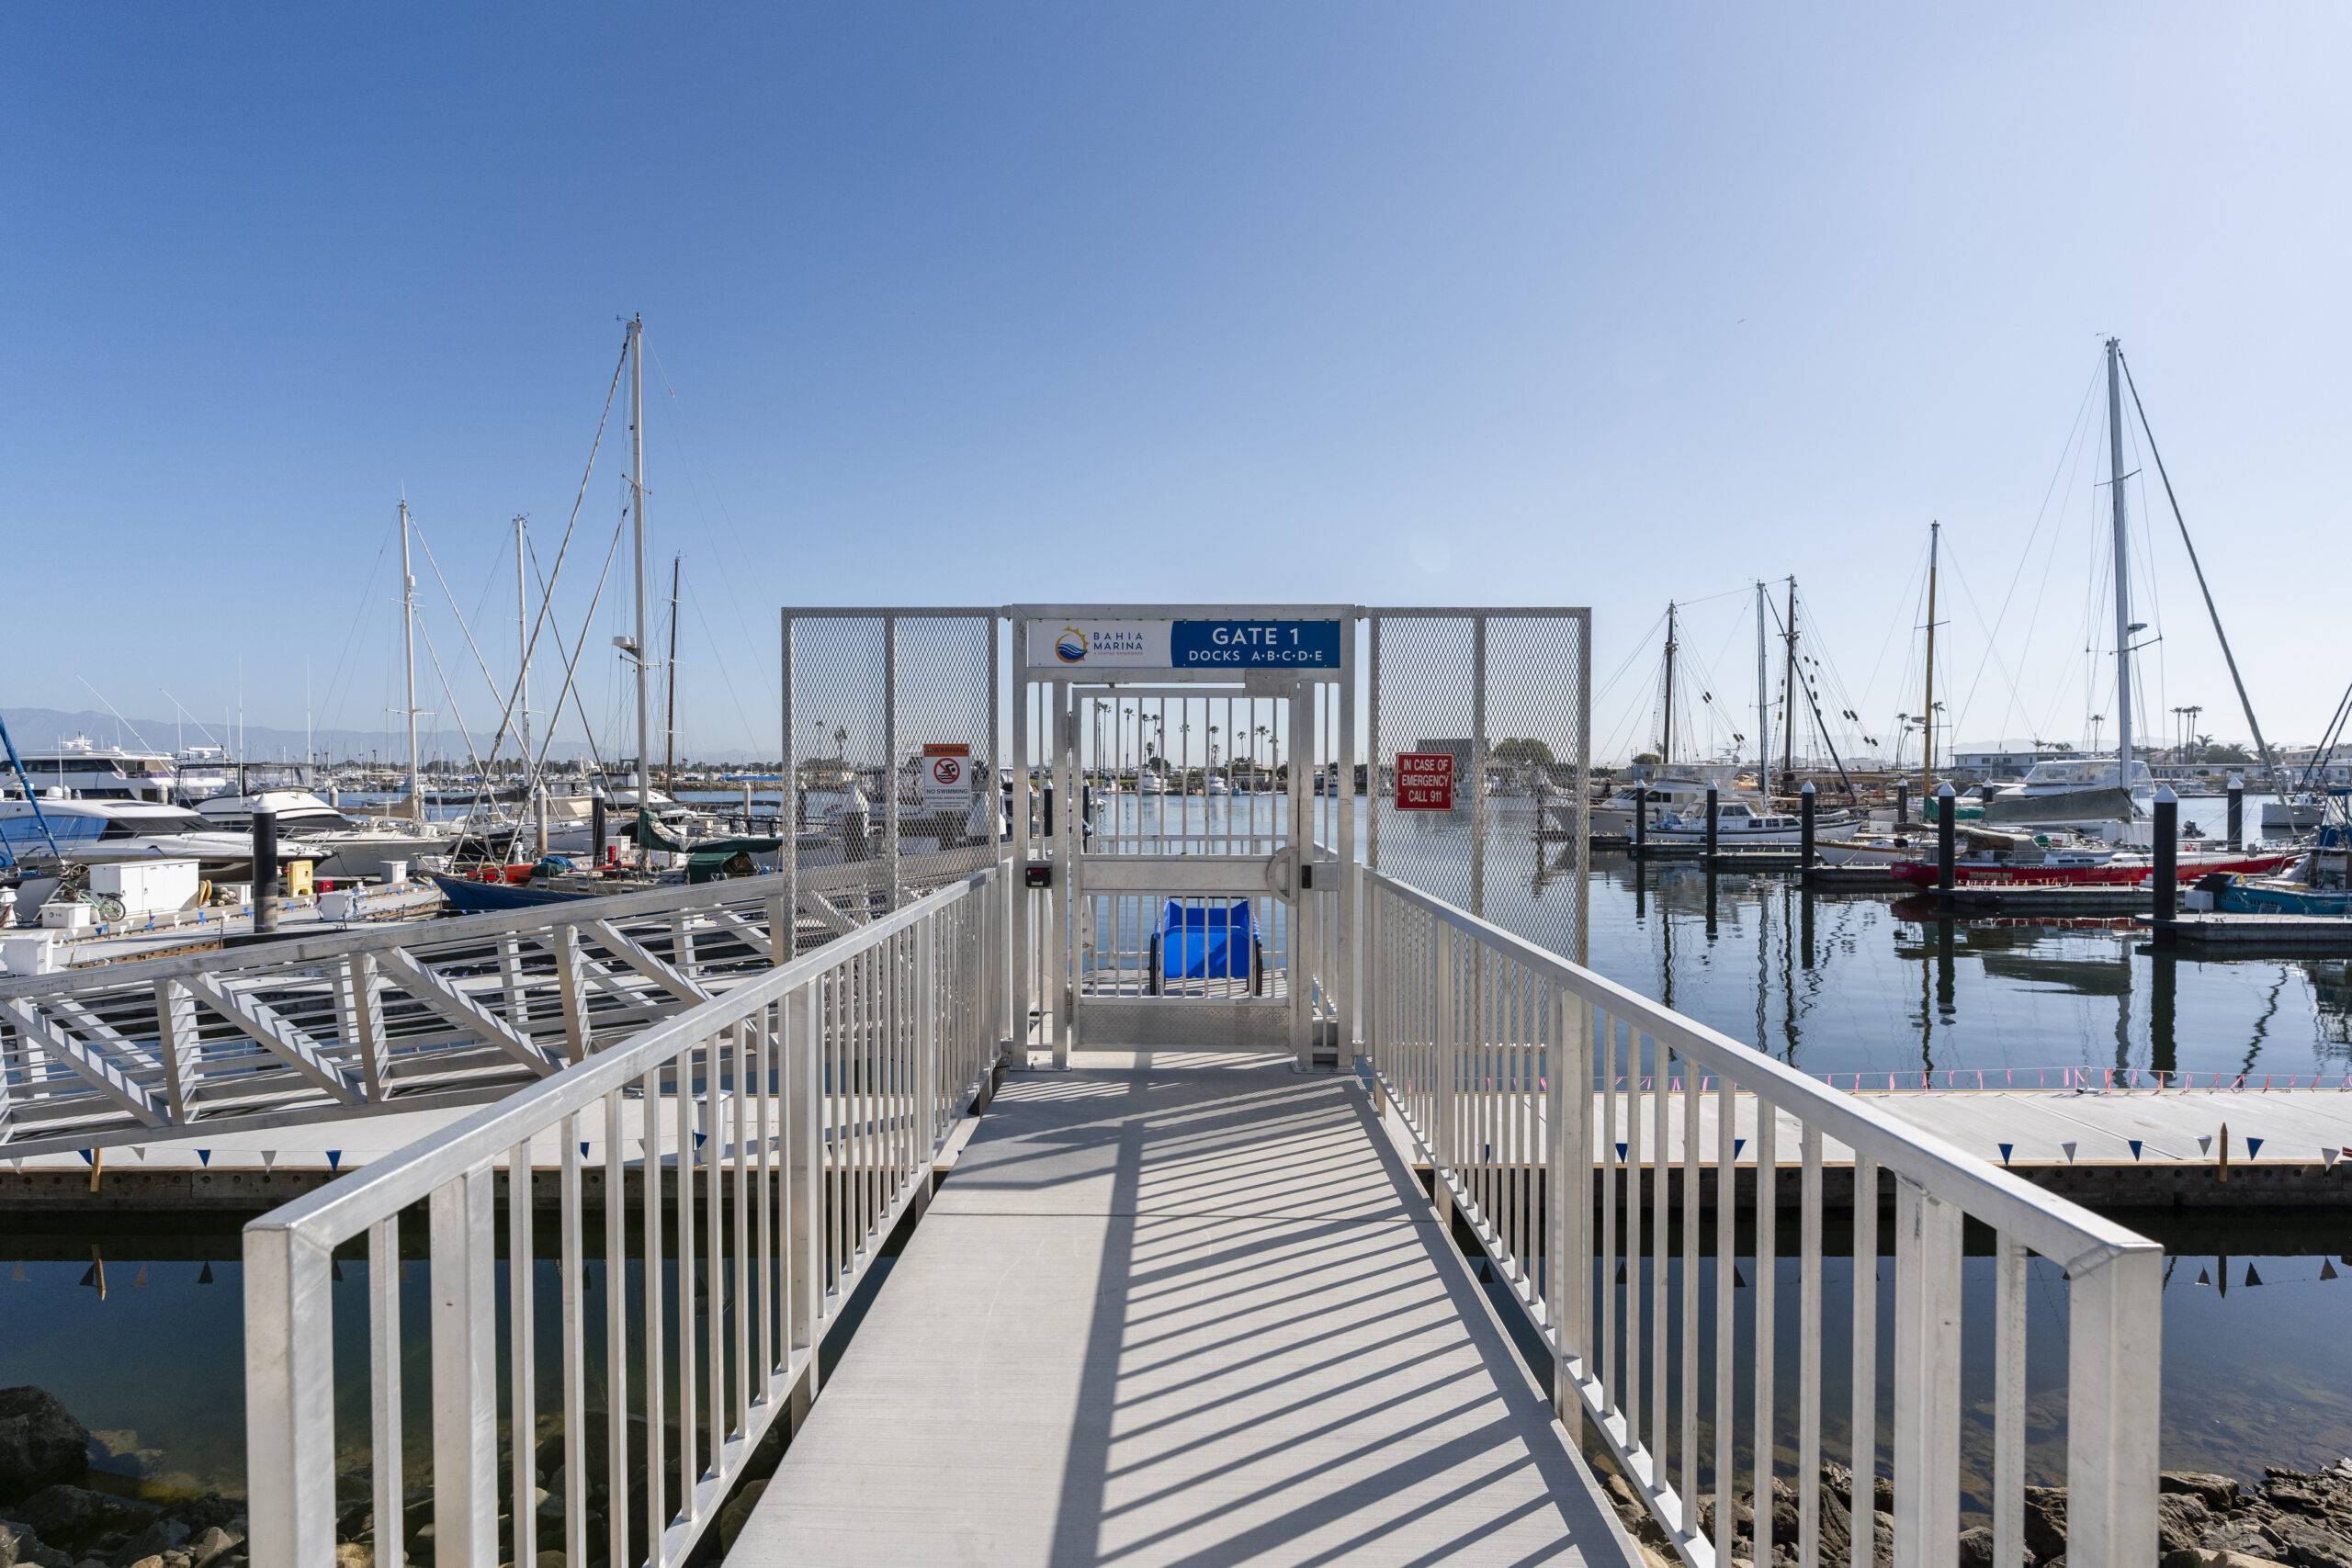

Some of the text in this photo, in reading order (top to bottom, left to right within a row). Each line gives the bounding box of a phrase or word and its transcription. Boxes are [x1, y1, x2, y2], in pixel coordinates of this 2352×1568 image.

[1094, 632, 1143, 640] BAHIA
[1212, 627, 1298, 645] GATE 1
[1094, 642, 1143, 650] MARINA
[1189, 650, 1240, 661] DOCKS
[1404, 760, 1448, 771] IN CASE OF
[1402, 775, 1449, 787] EMERGENCY
[1408, 790, 1442, 802] CALL 911
